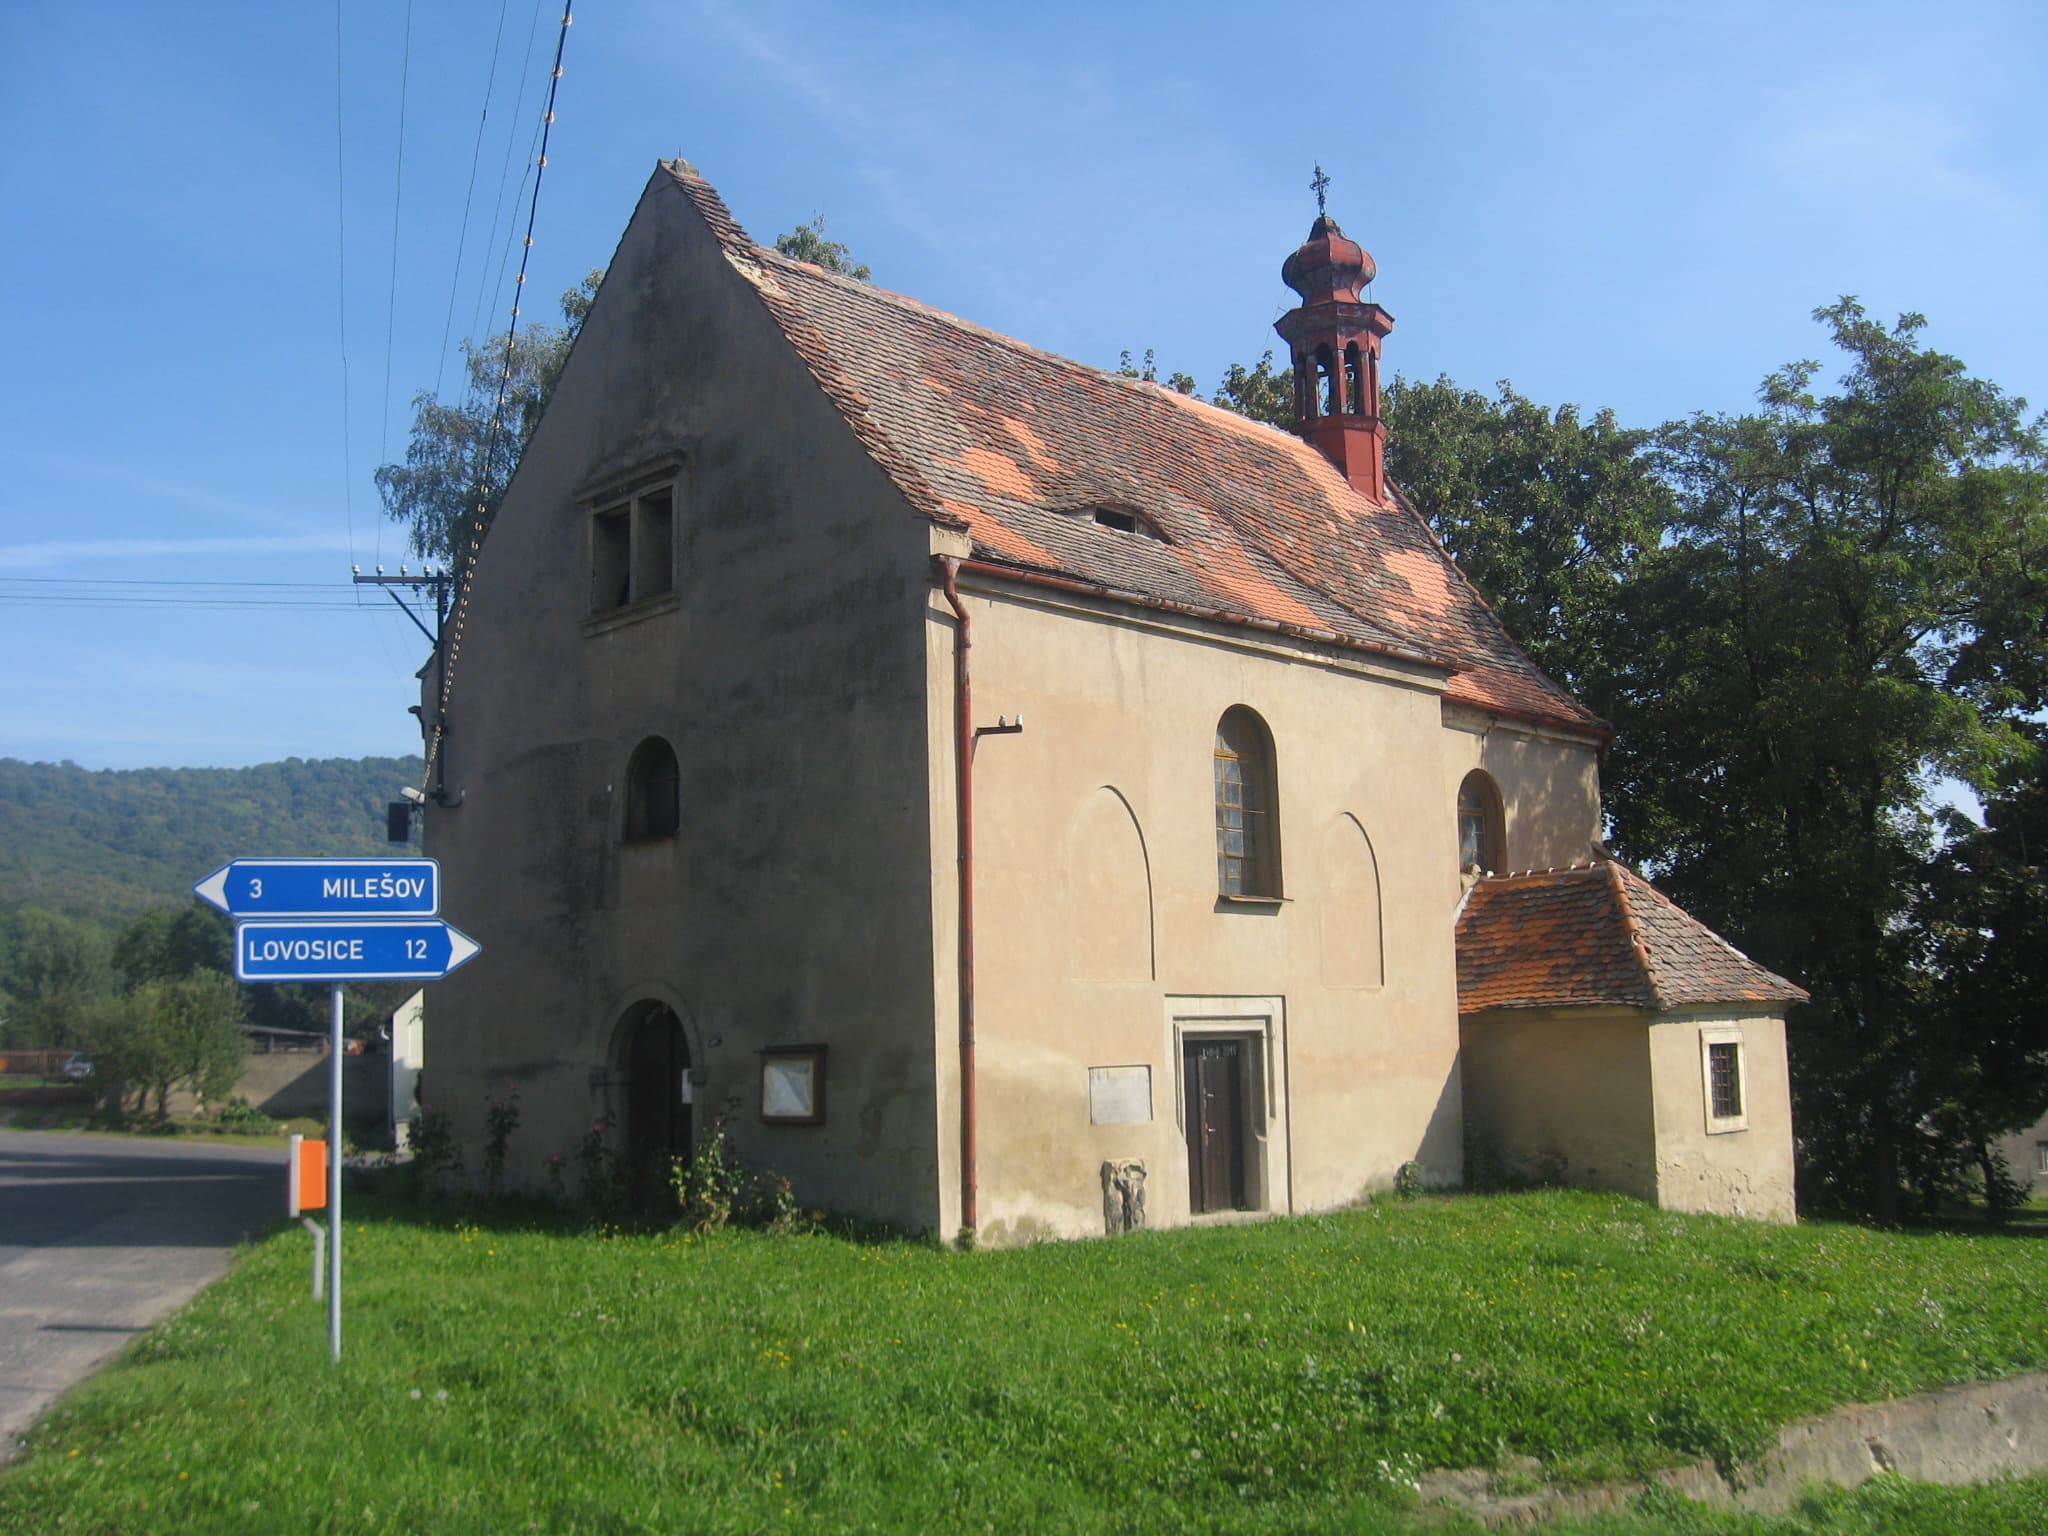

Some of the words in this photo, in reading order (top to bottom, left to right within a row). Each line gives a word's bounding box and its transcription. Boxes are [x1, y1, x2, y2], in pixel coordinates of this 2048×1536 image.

[249, 879, 262, 898] 3
[323, 872, 425, 898] MILEŠOV
[249, 939, 364, 961] LOVOSICE
[405, 939, 427, 959] 12
